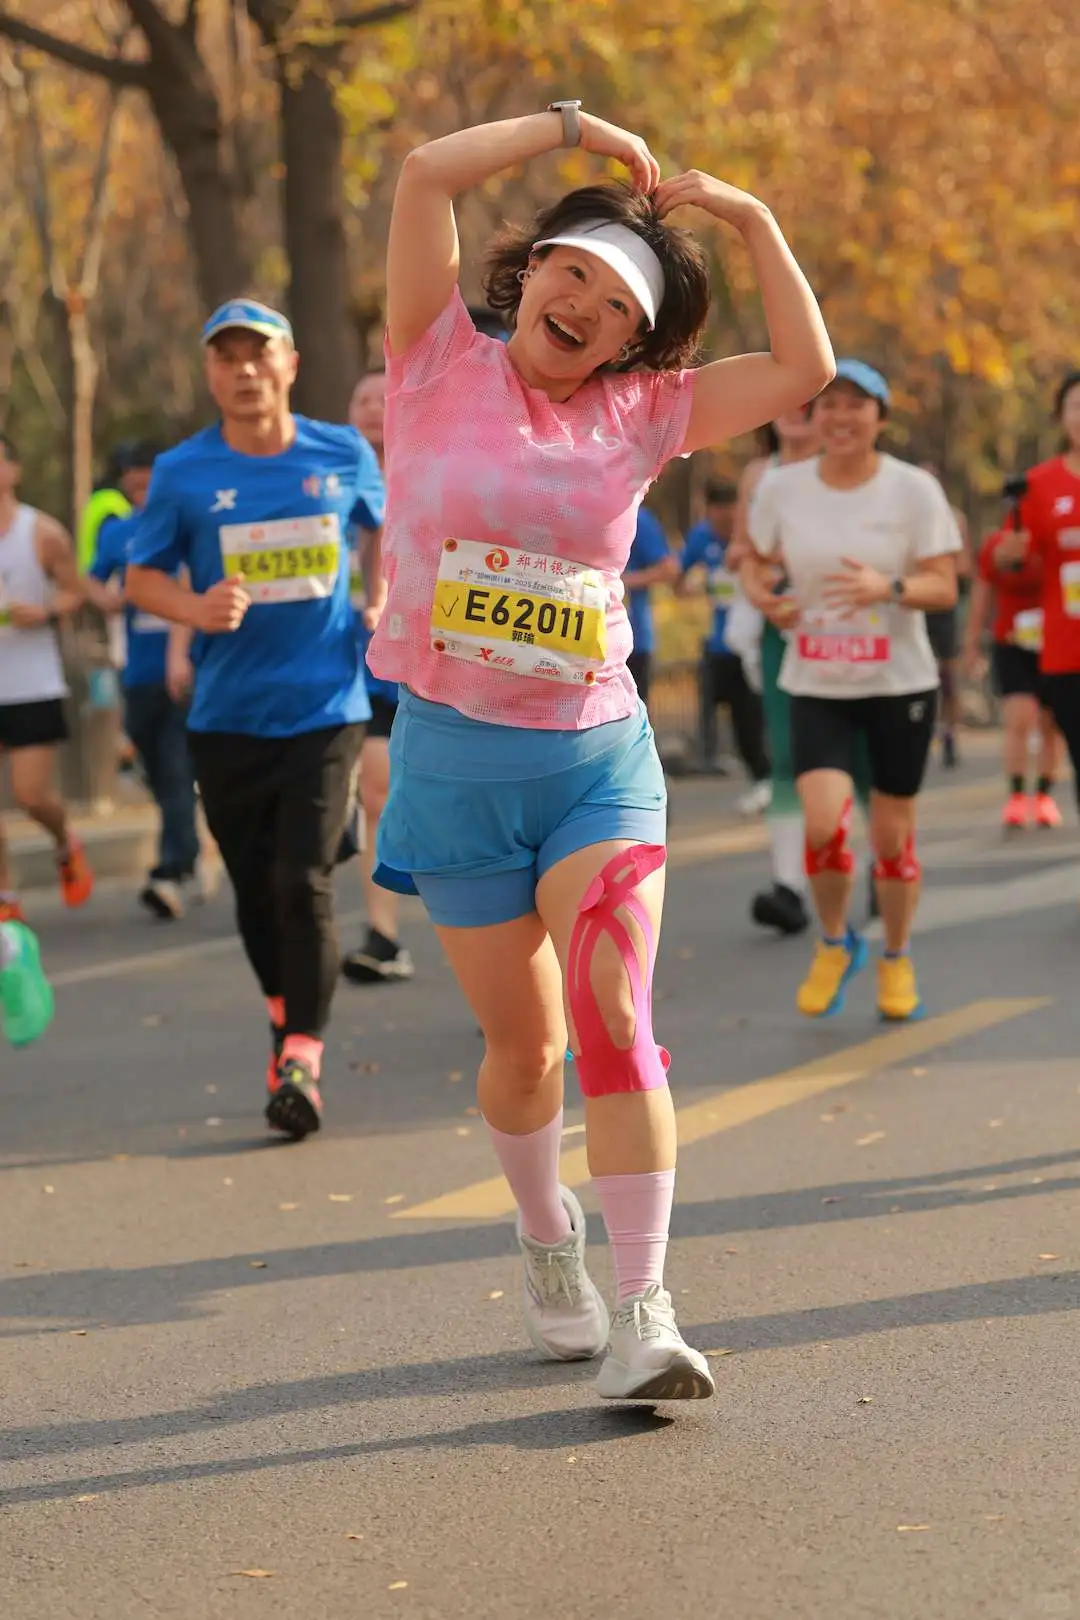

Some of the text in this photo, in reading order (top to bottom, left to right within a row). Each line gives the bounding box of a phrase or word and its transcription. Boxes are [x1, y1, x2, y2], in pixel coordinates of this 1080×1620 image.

[515, 554, 578, 577] 郑州银行
[465, 589, 585, 641] E62011
[511, 630, 536, 645] 郭瑜
